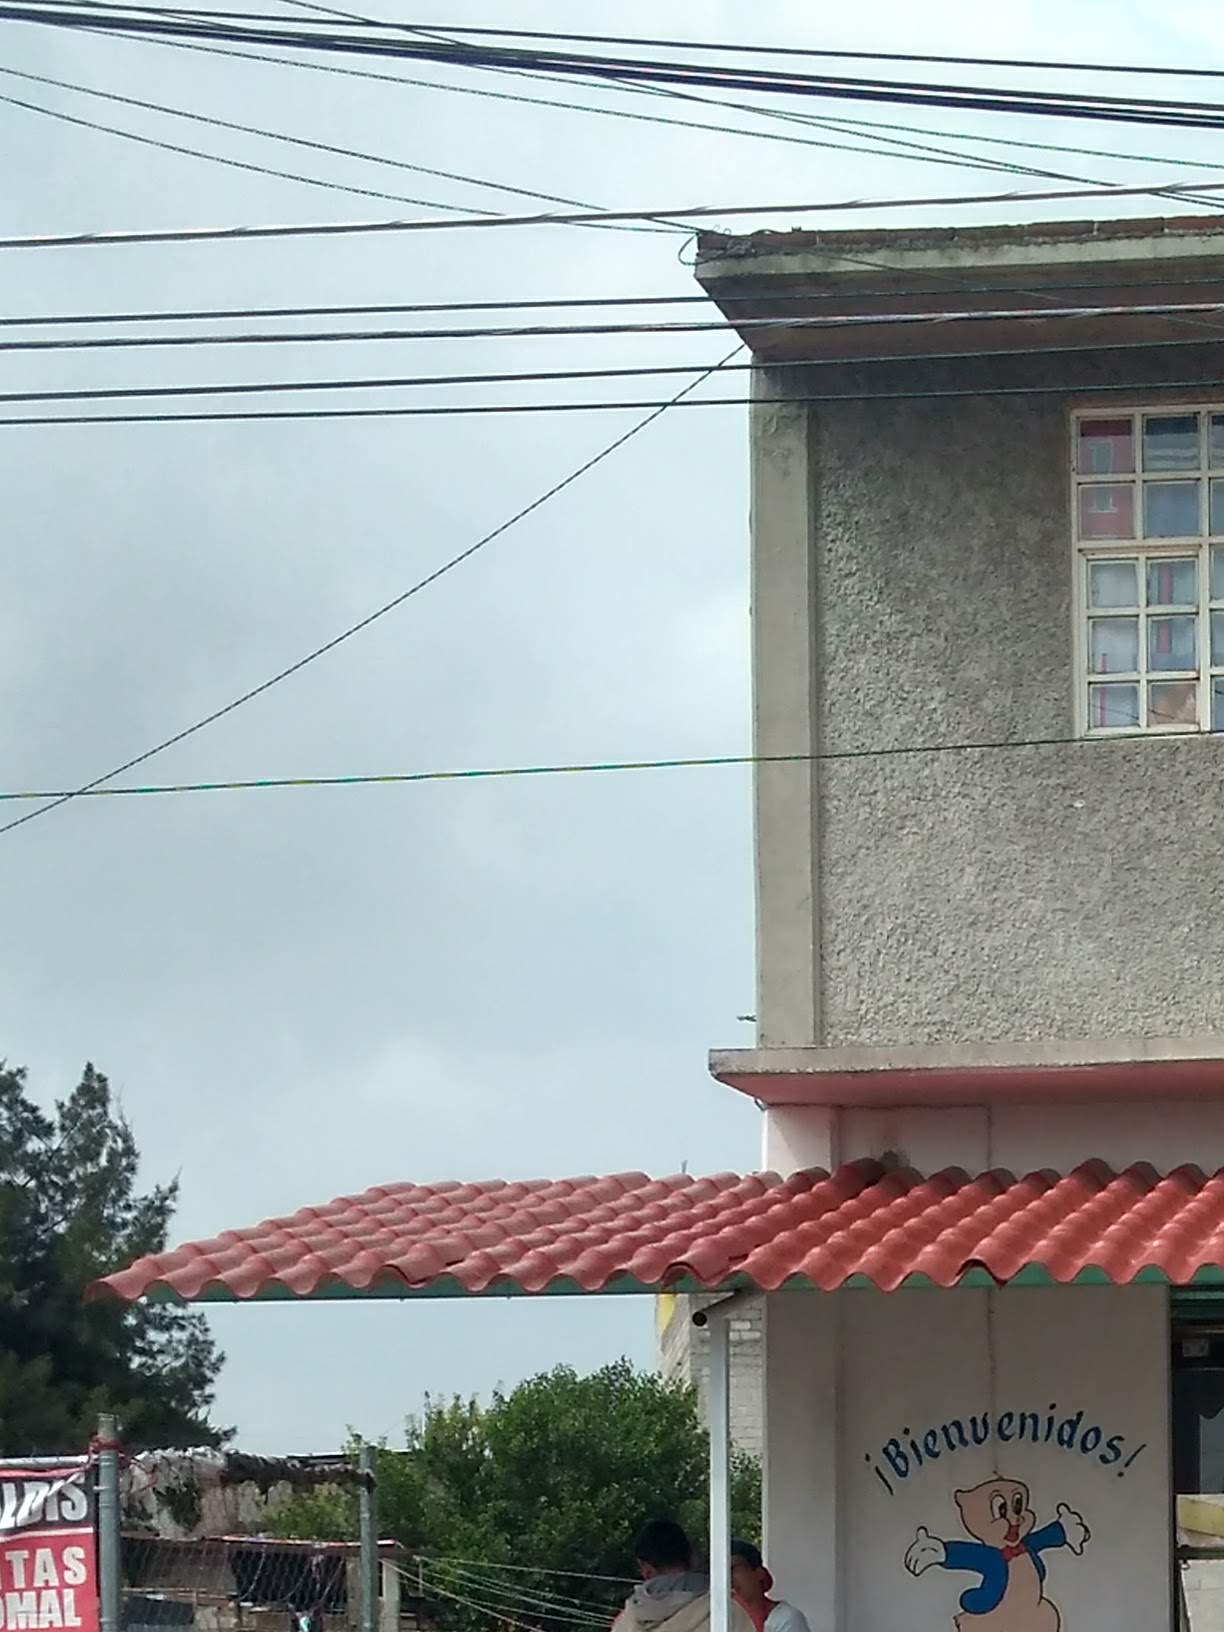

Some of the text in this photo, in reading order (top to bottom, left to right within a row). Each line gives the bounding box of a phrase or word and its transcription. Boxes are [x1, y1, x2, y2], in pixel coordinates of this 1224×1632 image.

[864, 1402, 1147, 1496] ¡Bienvenidos!
[0, 1473, 88, 1529] LDIS
[0, 1545, 87, 1590] TAS
